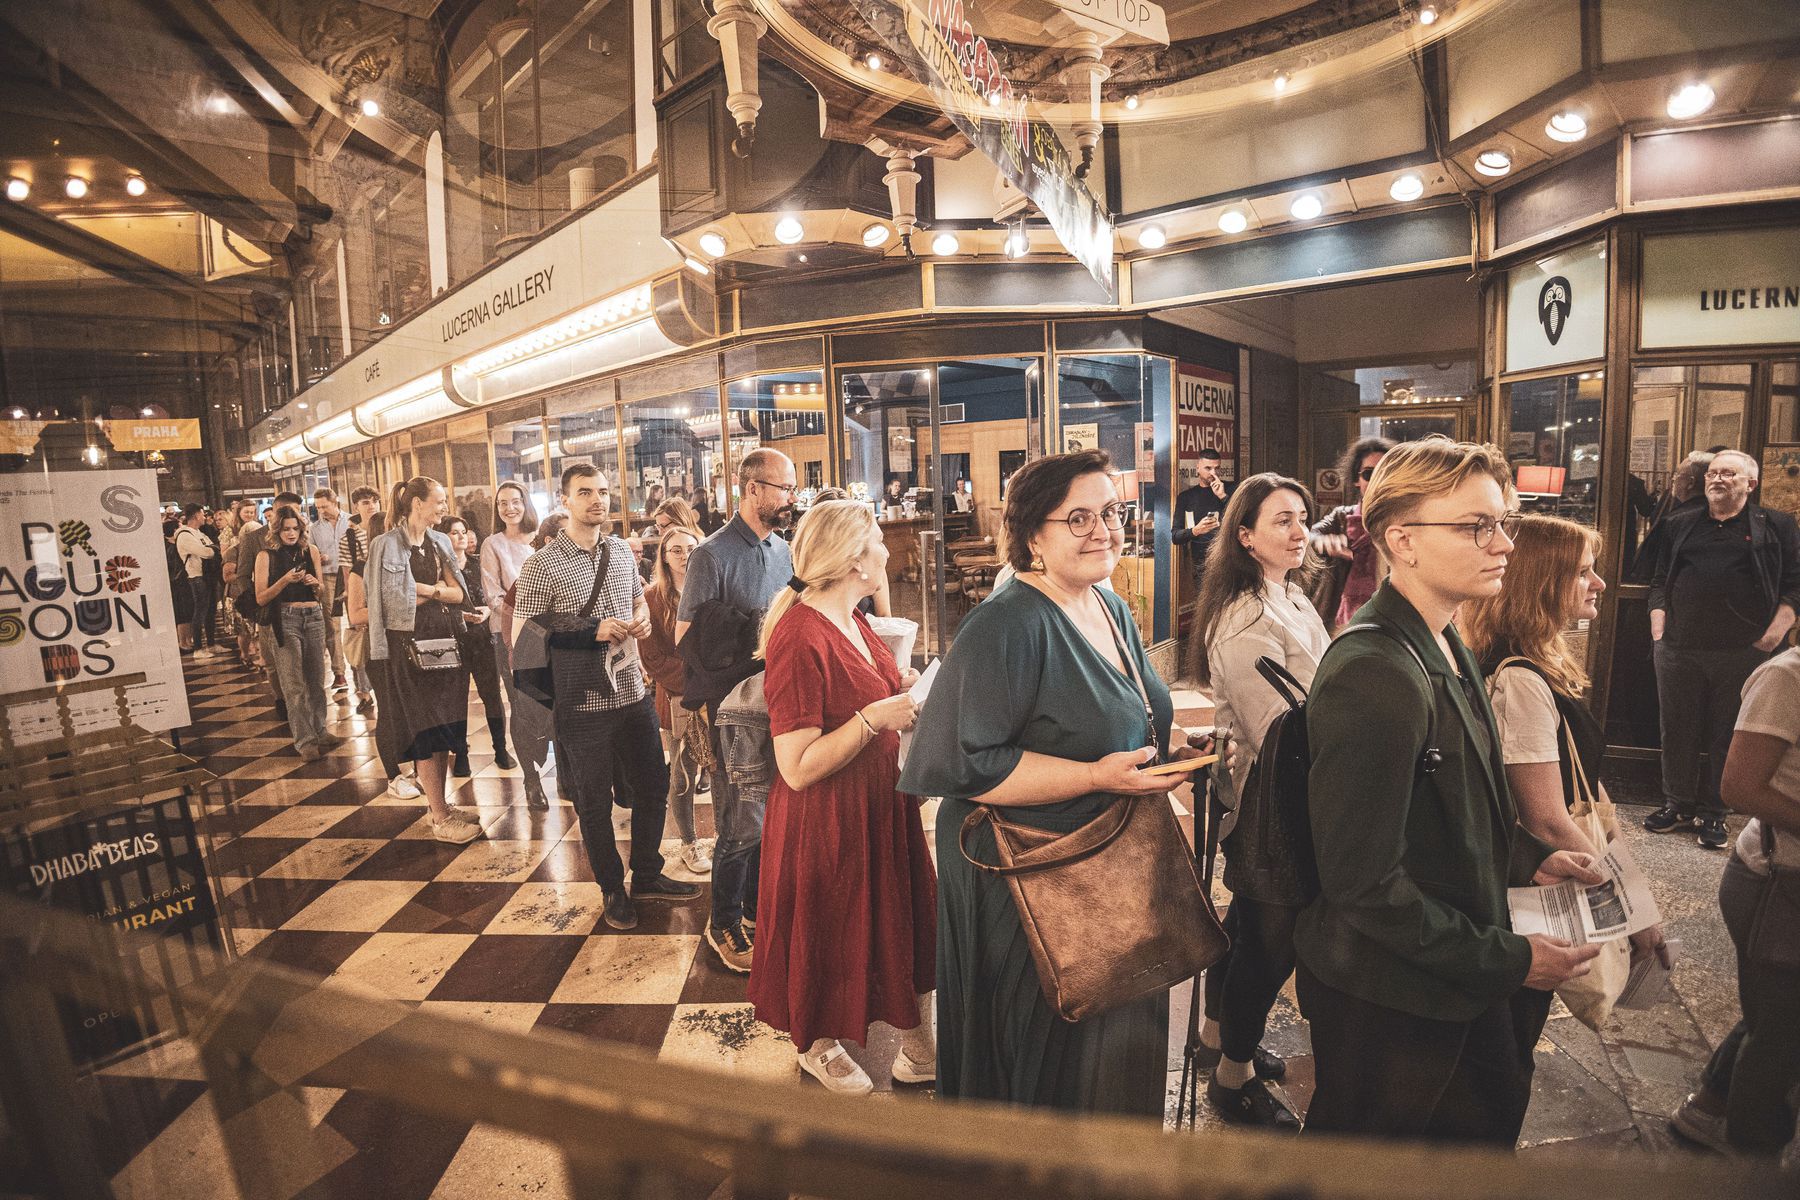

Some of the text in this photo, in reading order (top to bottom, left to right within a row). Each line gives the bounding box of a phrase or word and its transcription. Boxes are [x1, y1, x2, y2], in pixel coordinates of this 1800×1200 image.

[441, 264, 554, 343] LUCERNA GALLERY
[365, 358, 381, 383] CAFÉ
[1179, 380, 1234, 415] LUCERNA
[133, 425, 180, 438] PRAHA
[1179, 421, 1234, 453] TANEČNÍ
[30, 832, 159, 887] DHABA BEAS
[143, 883, 191, 904] VEGAN
